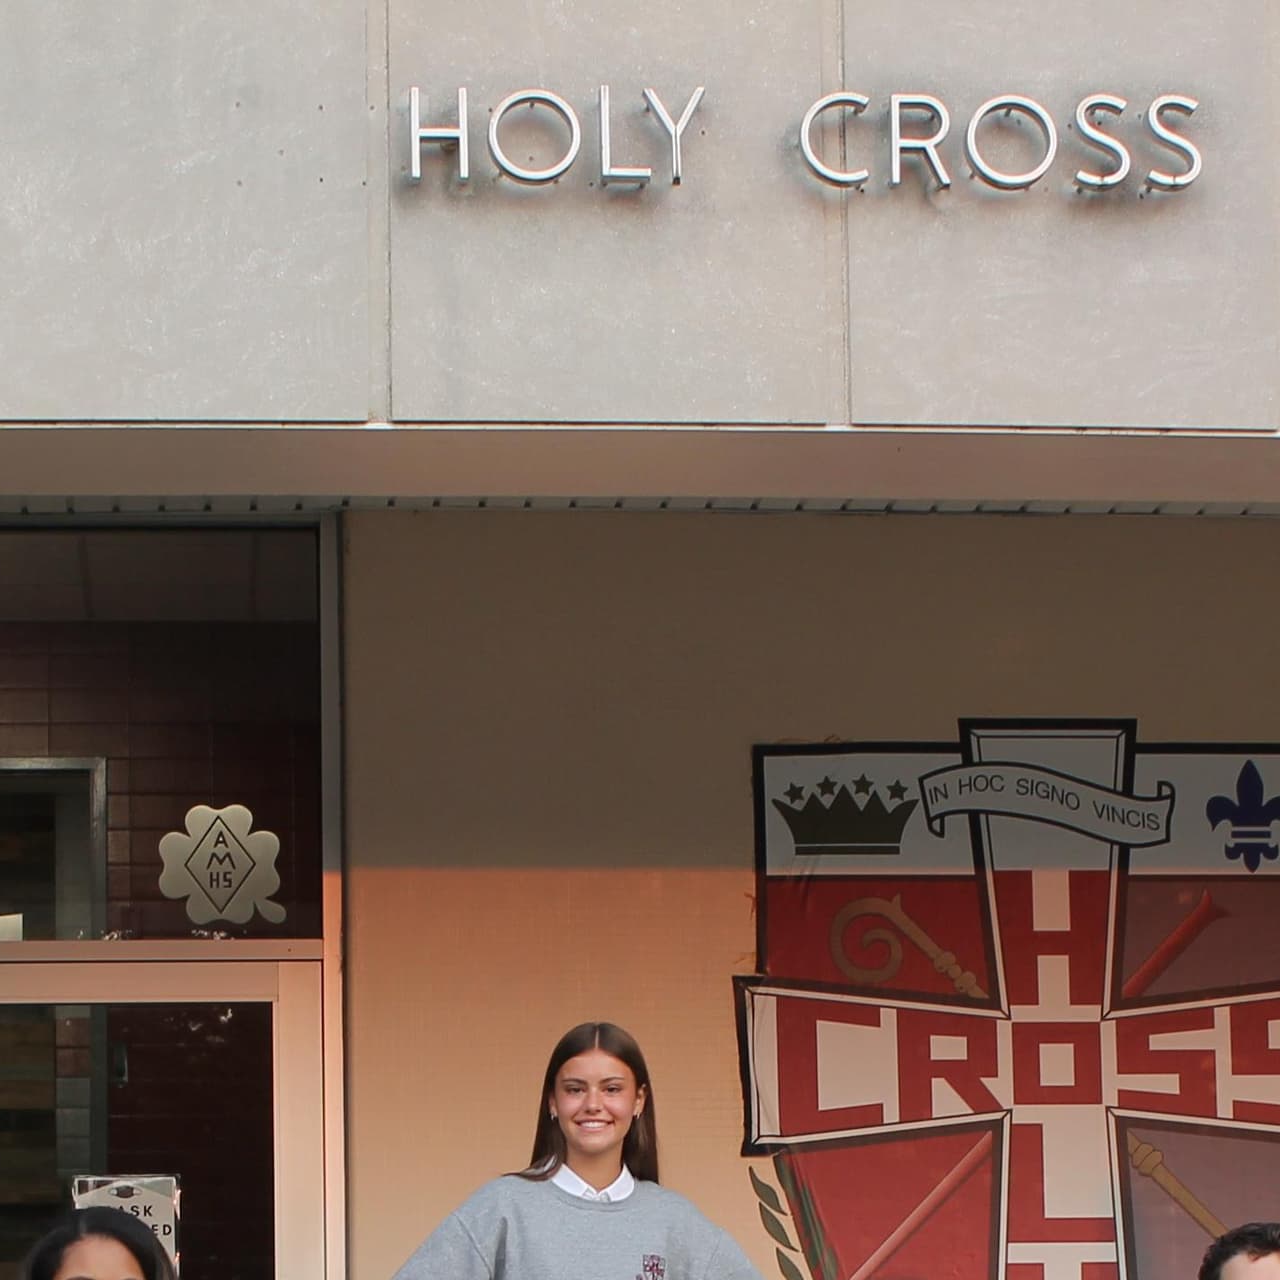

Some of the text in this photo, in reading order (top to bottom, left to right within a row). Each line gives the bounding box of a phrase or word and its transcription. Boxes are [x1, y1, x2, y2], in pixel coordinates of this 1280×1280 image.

[408, 83, 705, 186] HOLY
[800, 91, 1203, 191] CROSS
[928, 774, 1161, 831] IN HOC SIGNO VINCIS
